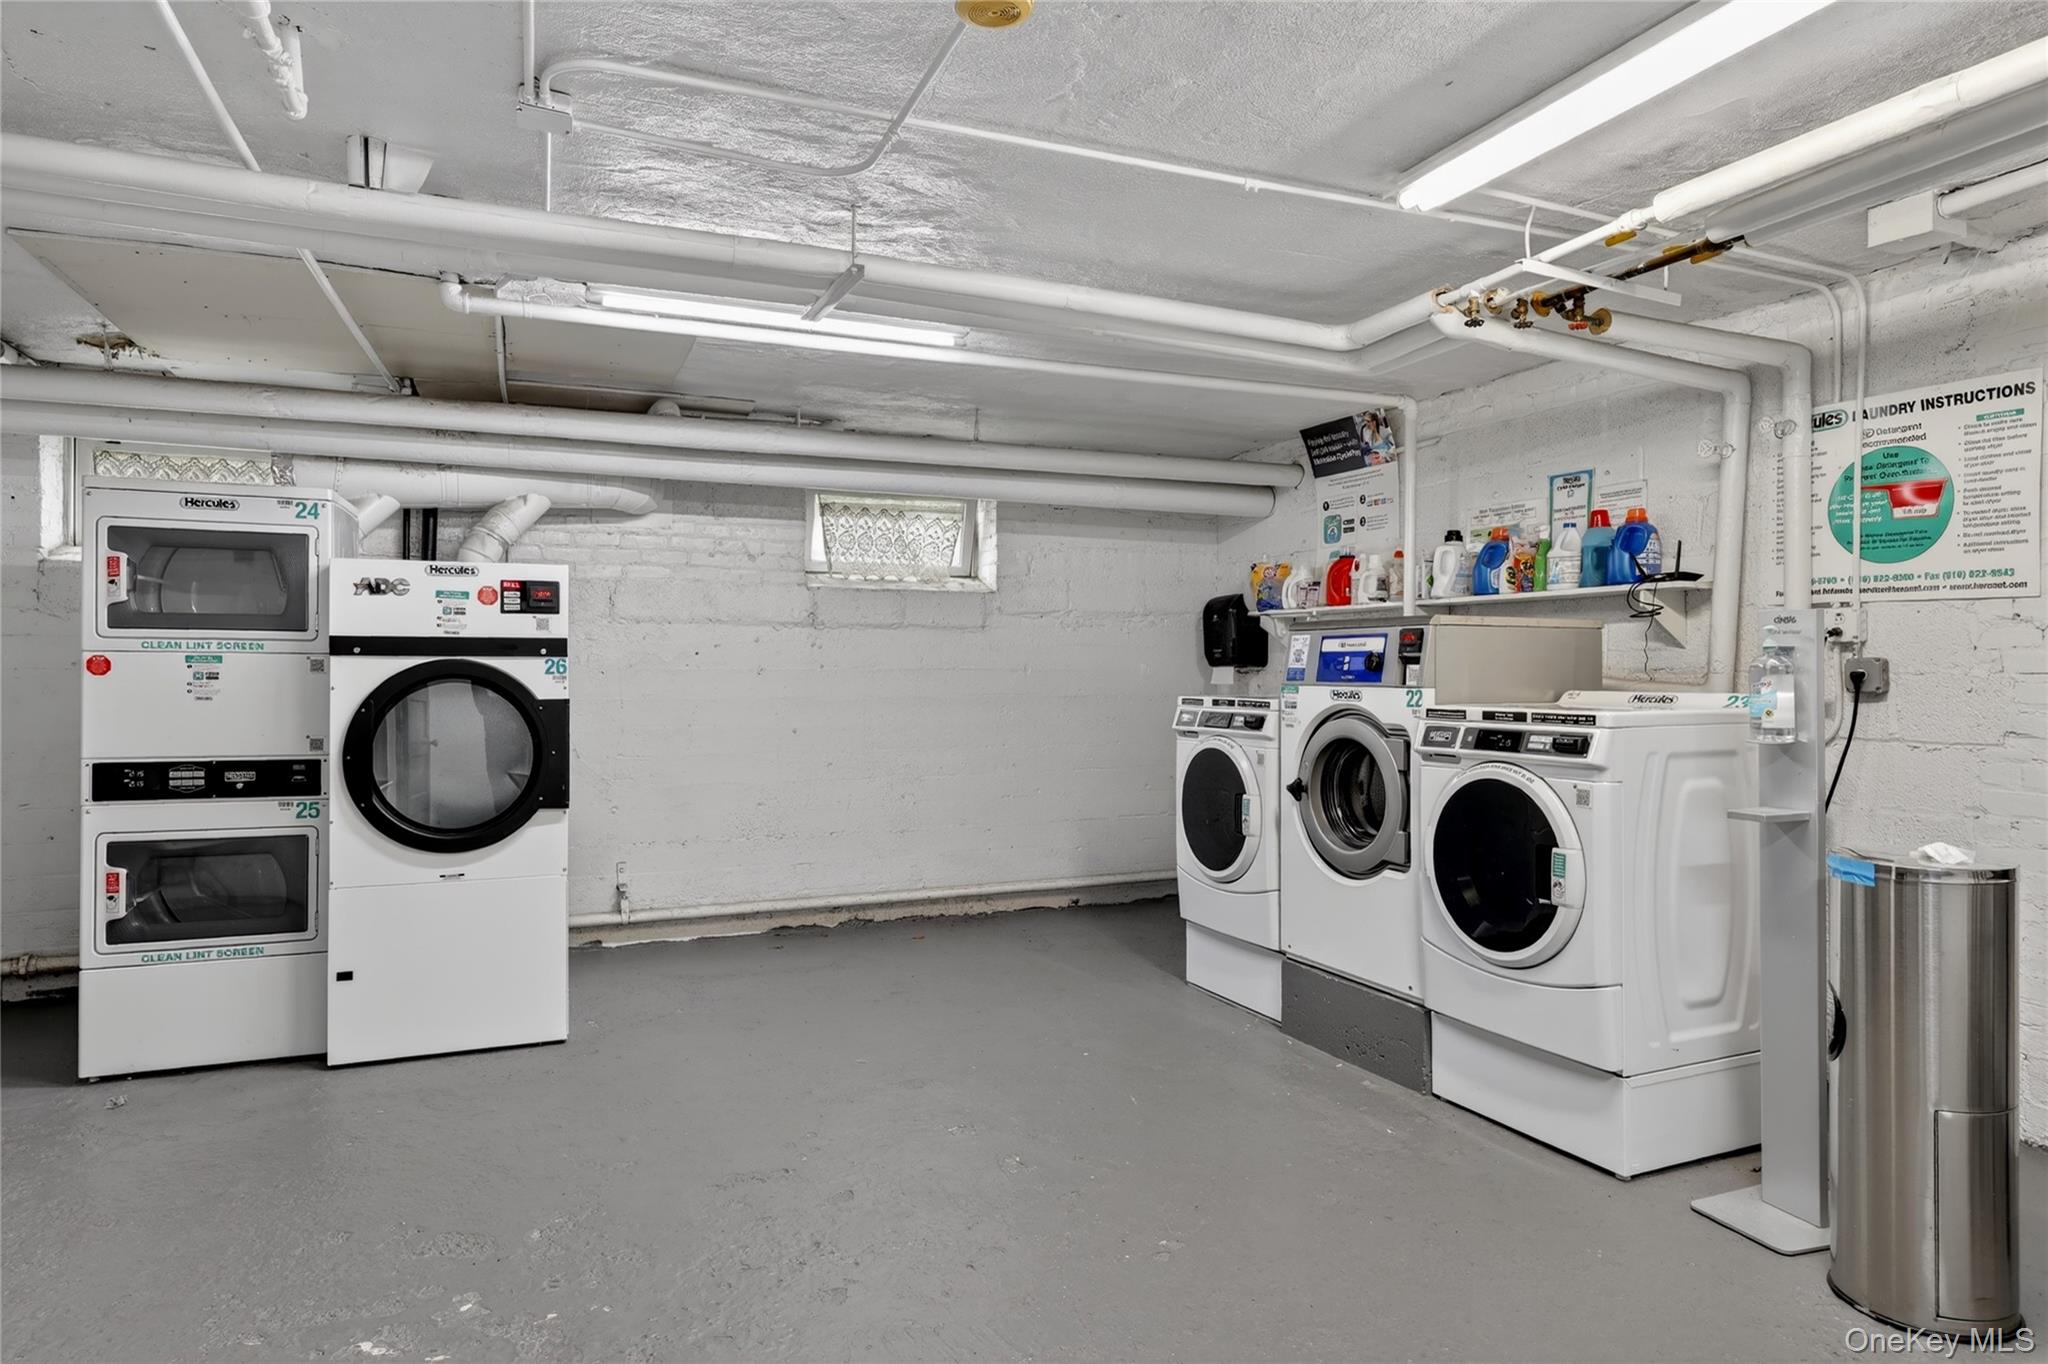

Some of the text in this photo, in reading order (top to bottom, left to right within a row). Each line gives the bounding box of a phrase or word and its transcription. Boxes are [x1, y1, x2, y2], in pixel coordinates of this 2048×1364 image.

[1921, 381, 2037, 411] INSTRUCTIONS
[1861, 433, 1927, 448] ecommended
[1883, 452, 1899, 460] Use
[183, 497, 236, 510] Hercules
[294, 501, 320, 520] 24
[428, 564, 477, 576] Hercules
[1924, 571, 1940, 580] Fax
[353, 577, 411, 597] ADC
[141, 641, 265, 651] CLEAN LINT SCREEN
[544, 658, 567, 676] 26
[1406, 690, 1423, 708] 22
[1631, 693, 1676, 705] Hercules
[296, 801, 321, 819] 25
[141, 947, 265, 964] CLEAN LINT SCREEN
